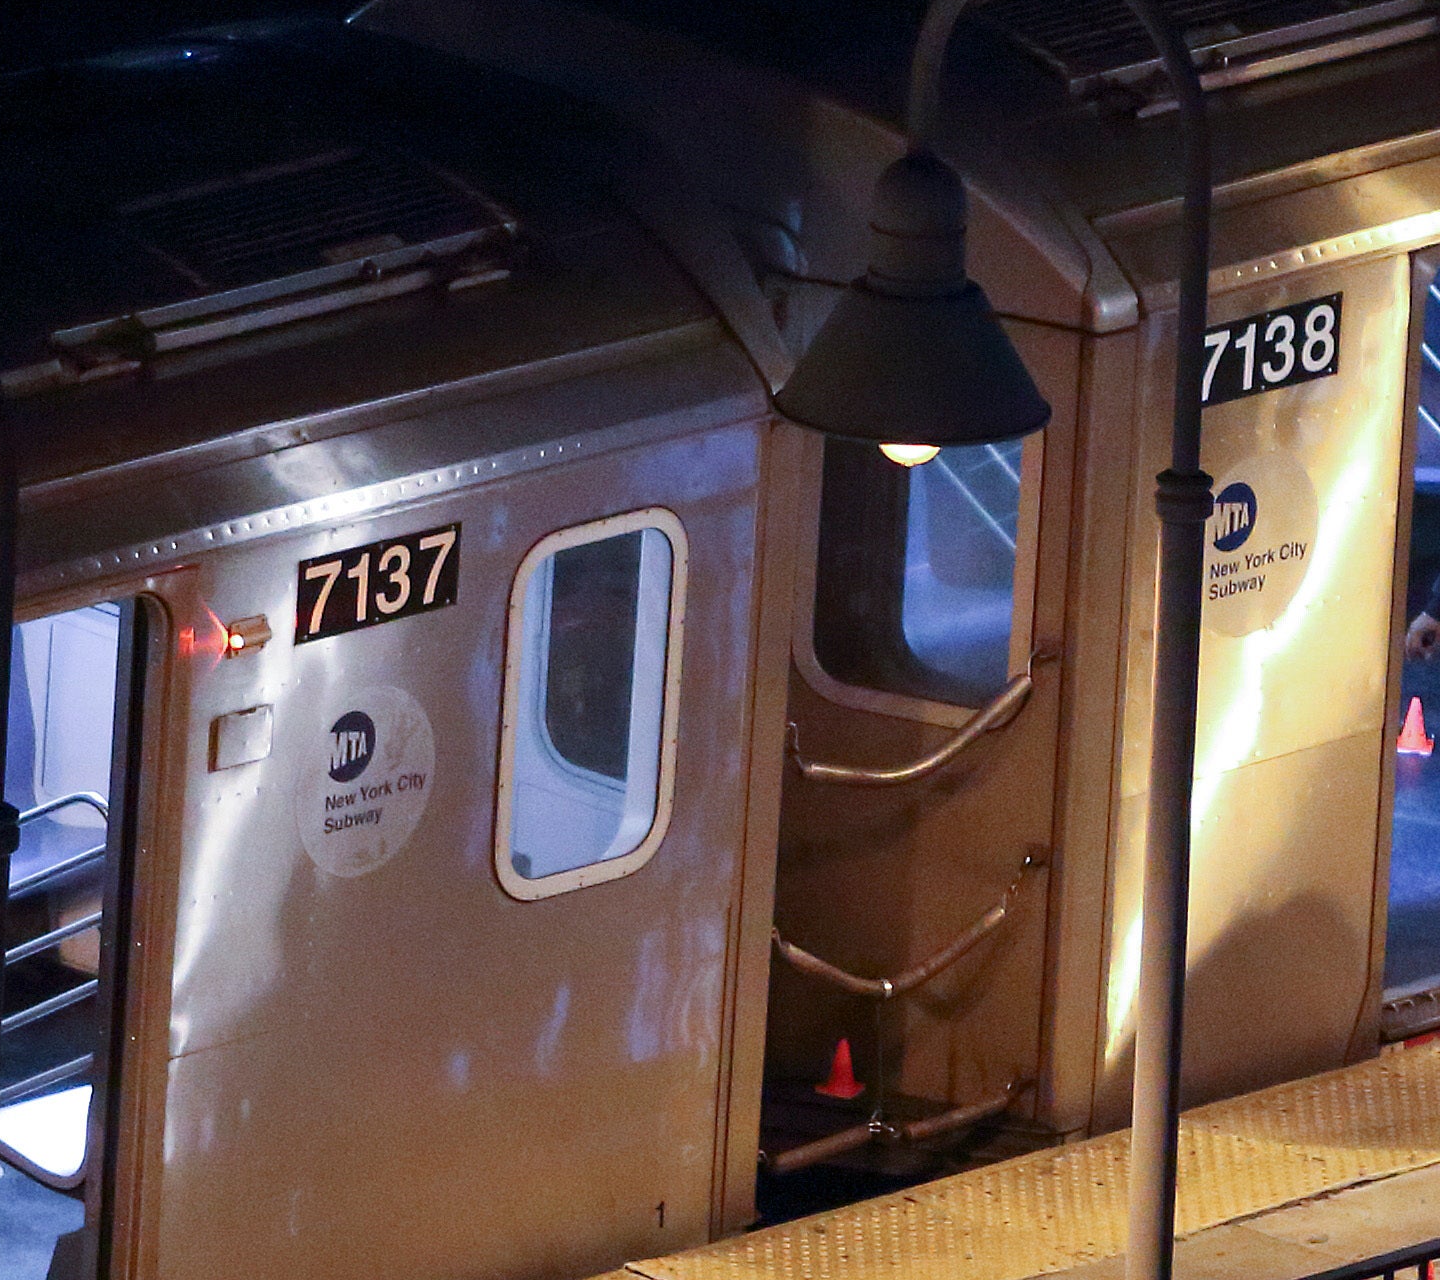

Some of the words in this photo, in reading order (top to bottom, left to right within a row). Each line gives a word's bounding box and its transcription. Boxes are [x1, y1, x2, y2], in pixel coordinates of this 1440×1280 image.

[1201, 305, 1335, 401] 7138
[1213, 502, 1250, 542] MTA
[1210, 561, 1240, 581] New
[1245, 549, 1277, 571] York
[1279, 541, 1308, 561] City
[305, 531, 456, 634] 7137
[1208, 573, 1267, 601] Subway
[328, 730, 368, 772] MTA
[325, 792, 357, 812] New
[360, 780, 393, 801] York
[398, 773, 426, 791] City
[323, 807, 383, 835] Subway
[655, 1200, 665, 1228] 1
